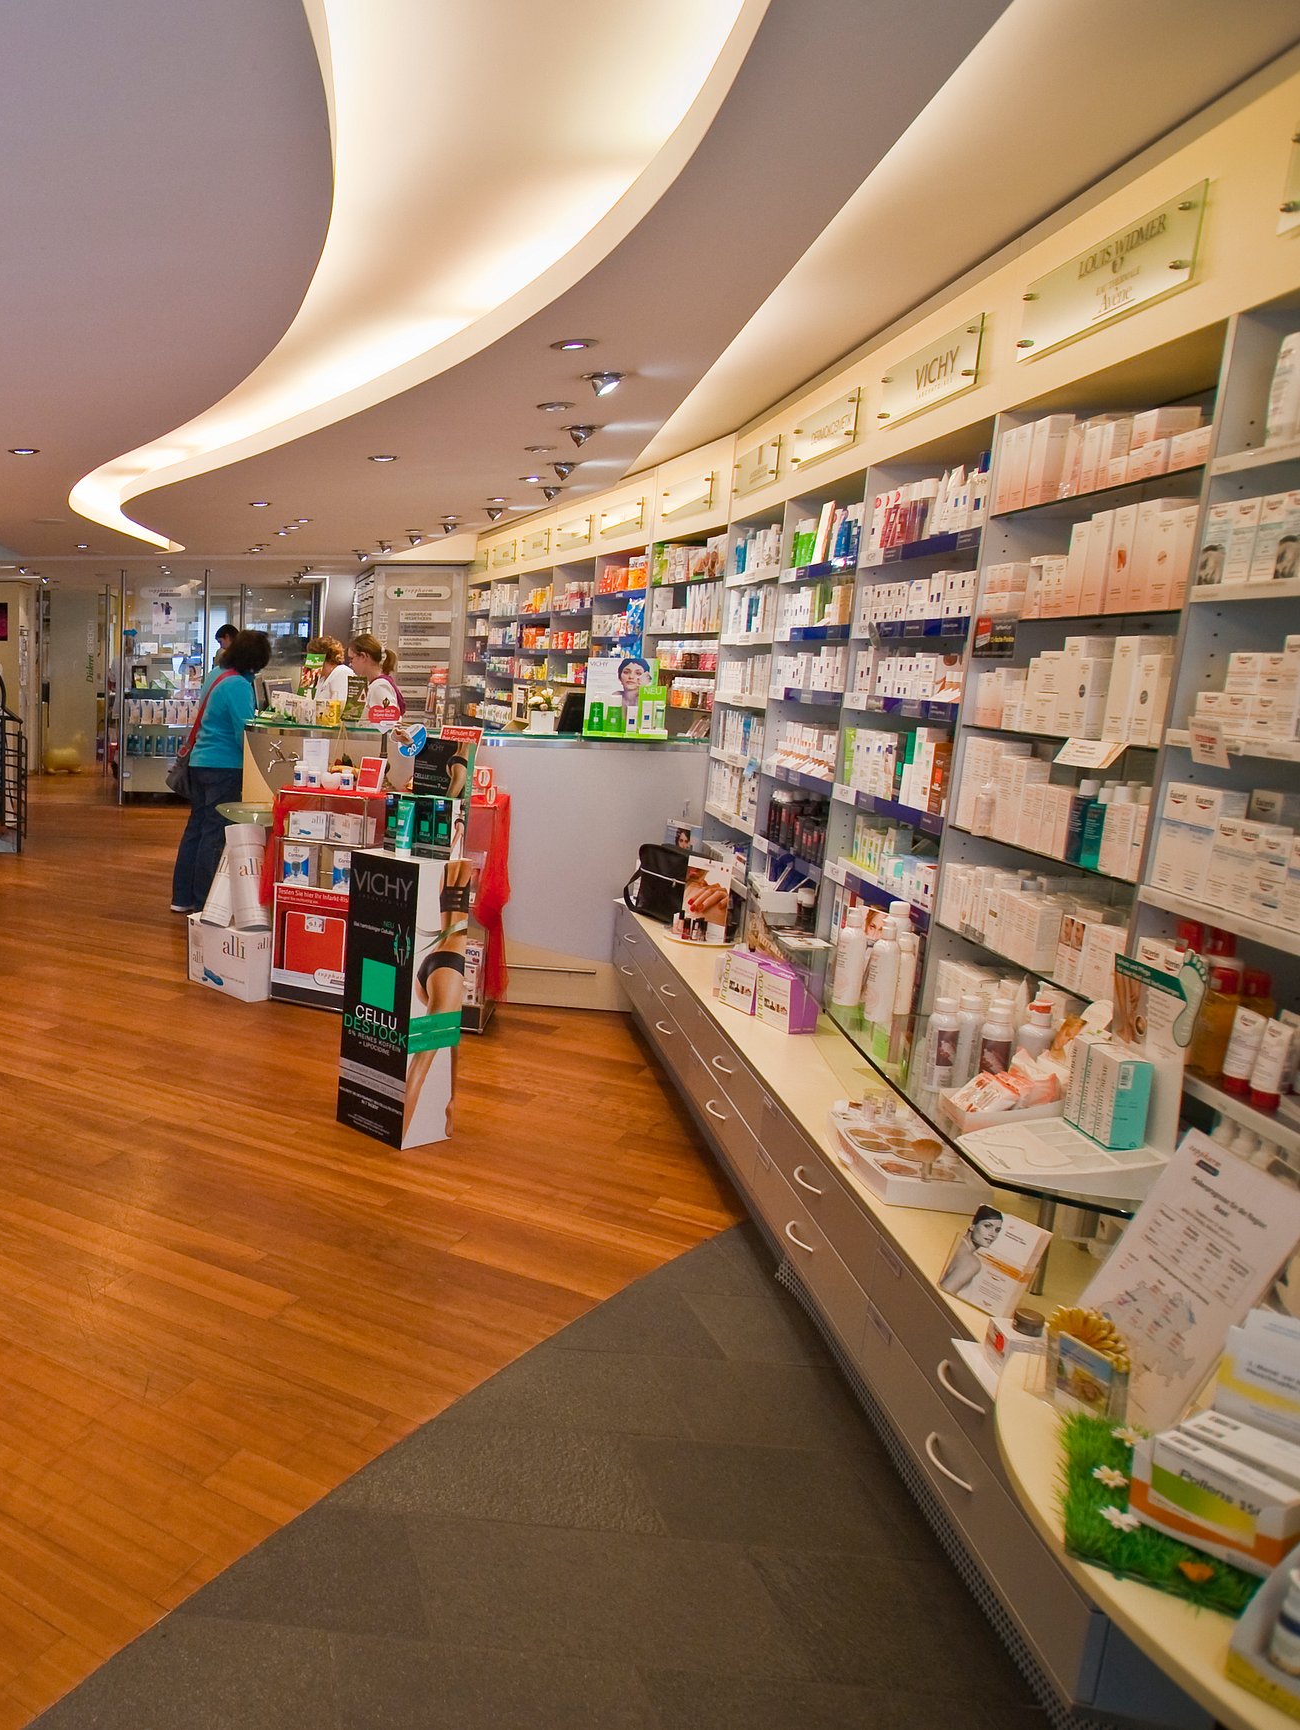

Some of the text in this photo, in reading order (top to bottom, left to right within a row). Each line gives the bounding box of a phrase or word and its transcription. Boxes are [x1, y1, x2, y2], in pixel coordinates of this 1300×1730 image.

[1077, 213, 1166, 280] LOUIS WIDMER
[915, 346, 960, 391] VICHY
[86, 655, 95, 684] Diskret
[643, 687, 663, 695] NEU
[1195, 794, 1215, 806] Eucerin
[311, 815, 325, 825] alli
[239, 858, 263, 877] alli
[278, 887, 295, 896] Testen
[295, 889, 303, 897] Sie
[304, 891, 314, 899] hier
[314, 892, 323, 900] Ihr
[353, 867, 413, 902] VICHY
[383, 920, 395, 929] NEU
[222, 935, 246, 960] alli
[355, 1004, 398, 1031] CELLU
[343, 1013, 407, 1049] DESTOCK
[358, 1032, 378, 1046] REINES
[378, 1037, 401, 1053] KOFFEIN
